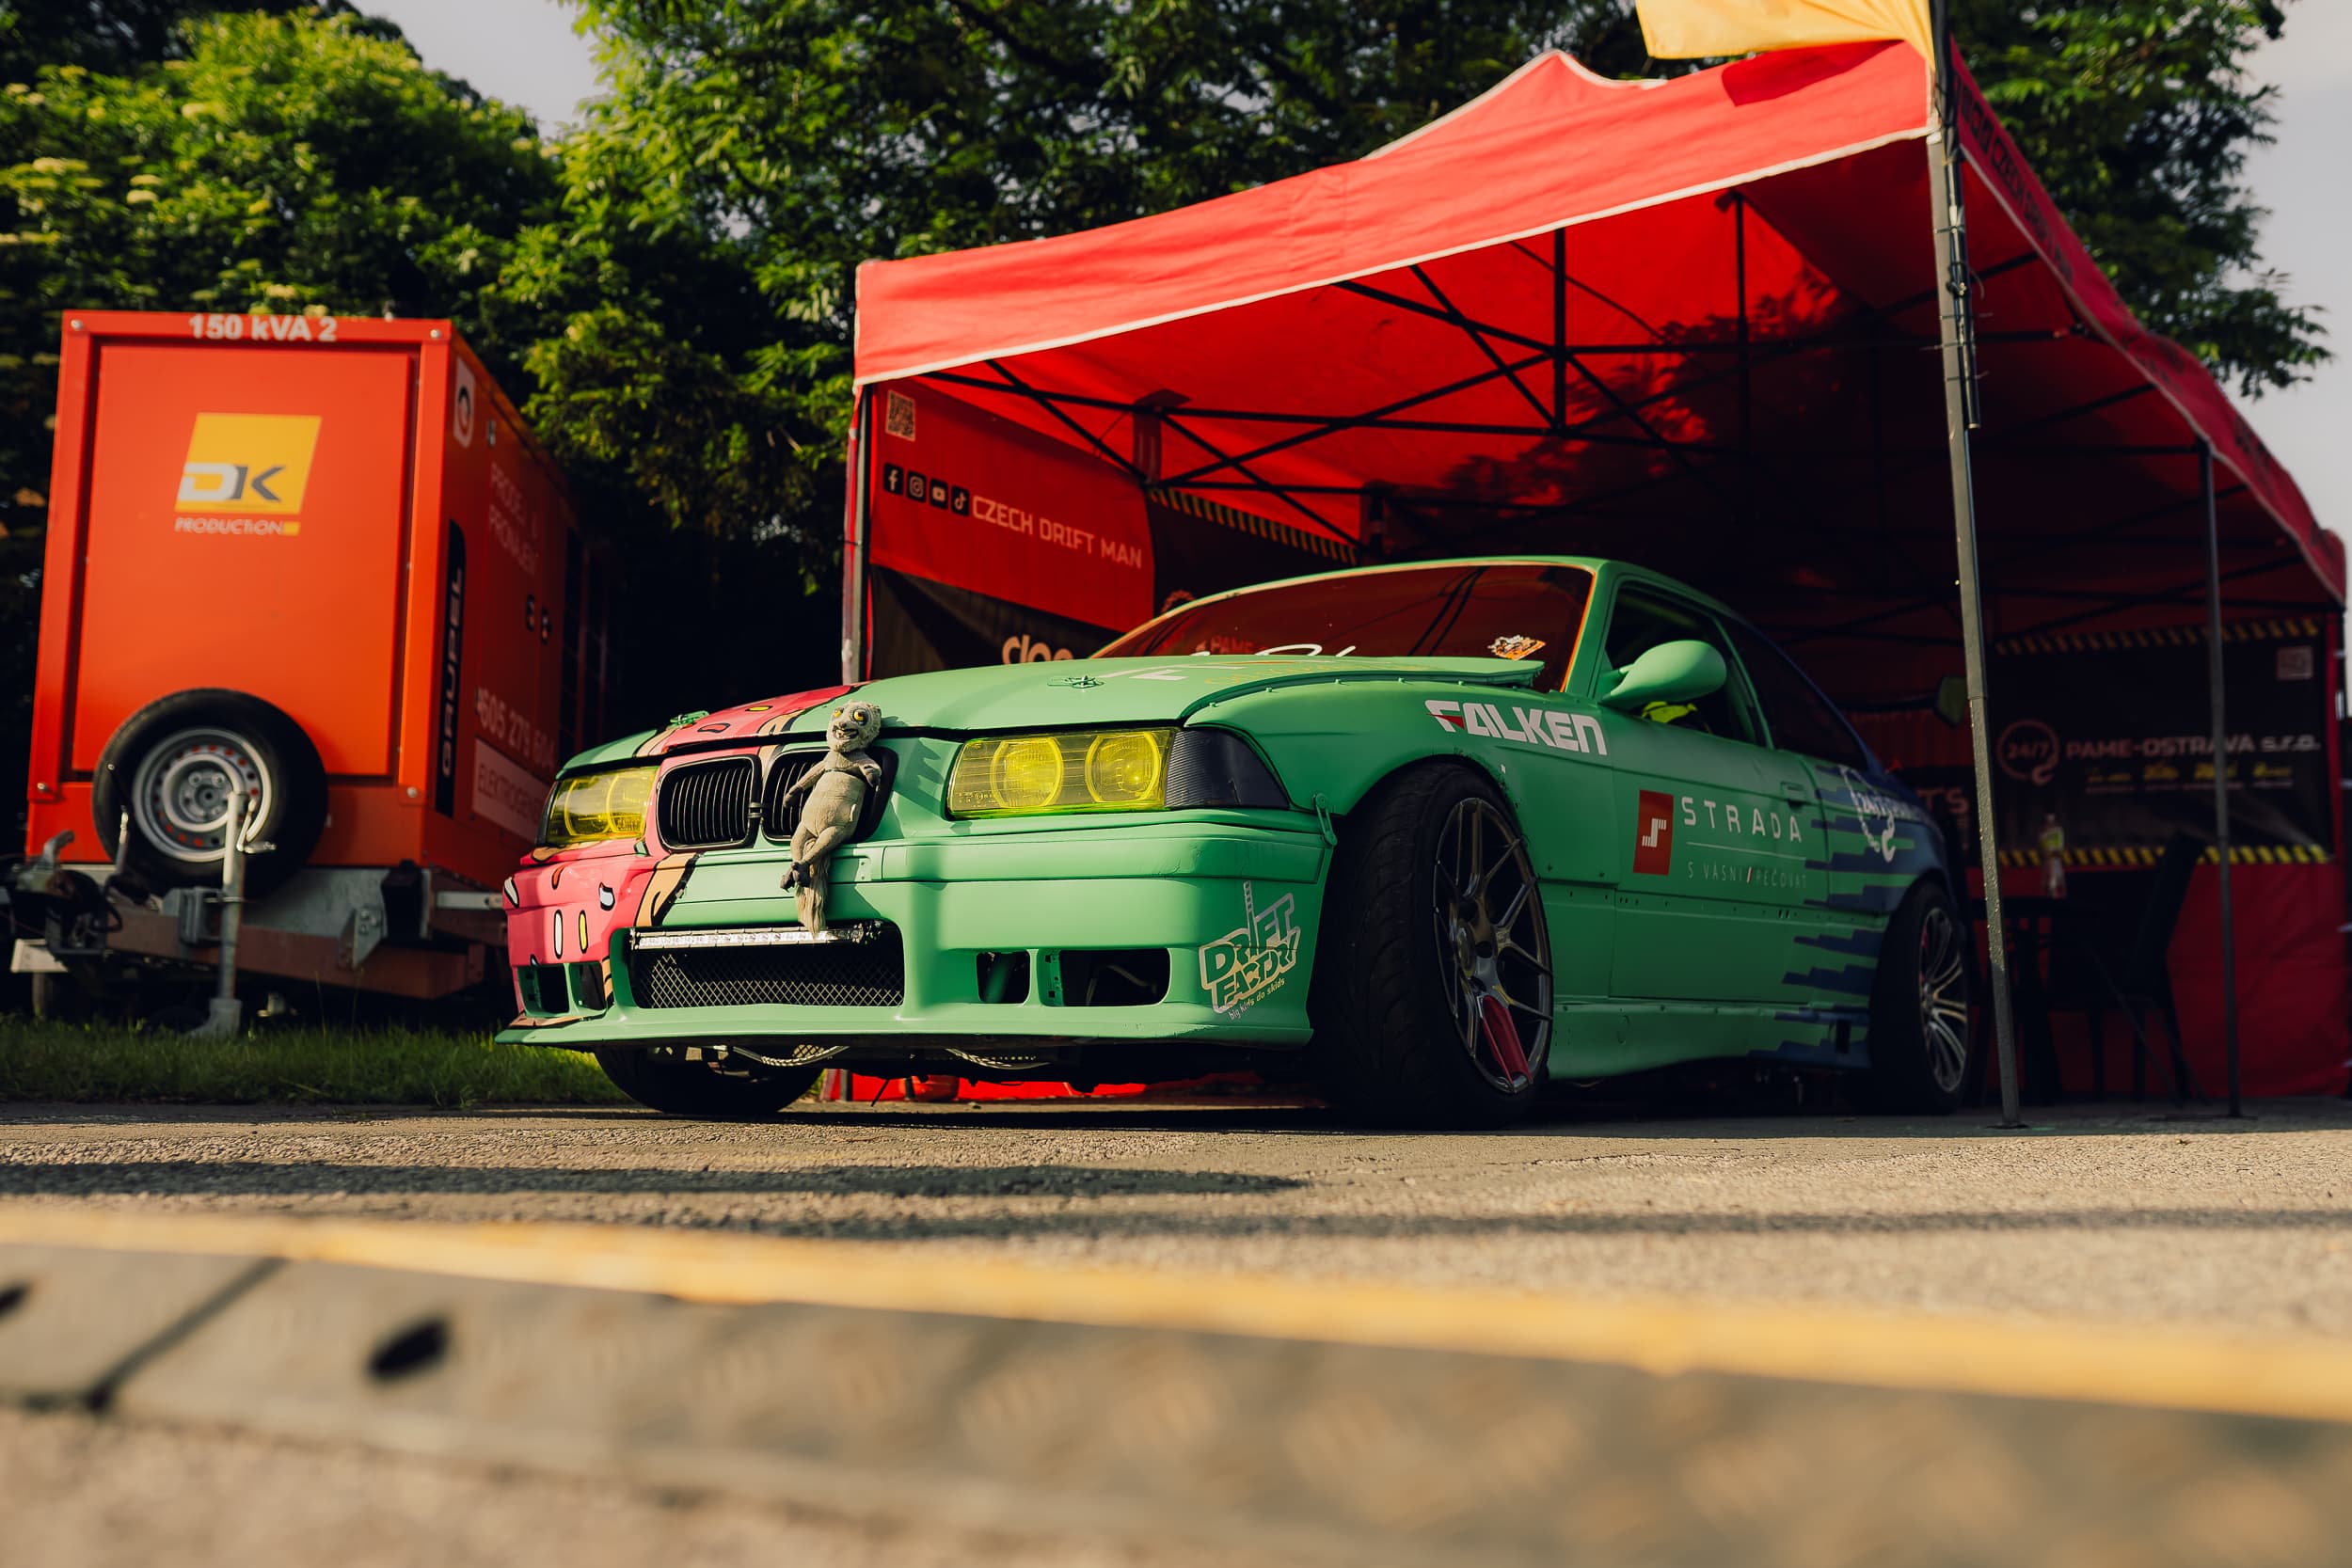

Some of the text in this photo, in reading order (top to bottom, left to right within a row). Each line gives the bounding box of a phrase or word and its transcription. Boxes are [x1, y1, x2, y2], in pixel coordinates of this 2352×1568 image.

[189, 313, 338, 341] 150 kVA 2
[178, 463, 287, 503] DK
[973, 495, 1141, 569] CZECH DRIFT MAN
[1423, 700, 1608, 756] FALKEN
[1681, 796, 1803, 843] STRADA
[1200, 881, 1295, 987] DRIFT
[1228, 977, 1285, 1021] big kids do skids
